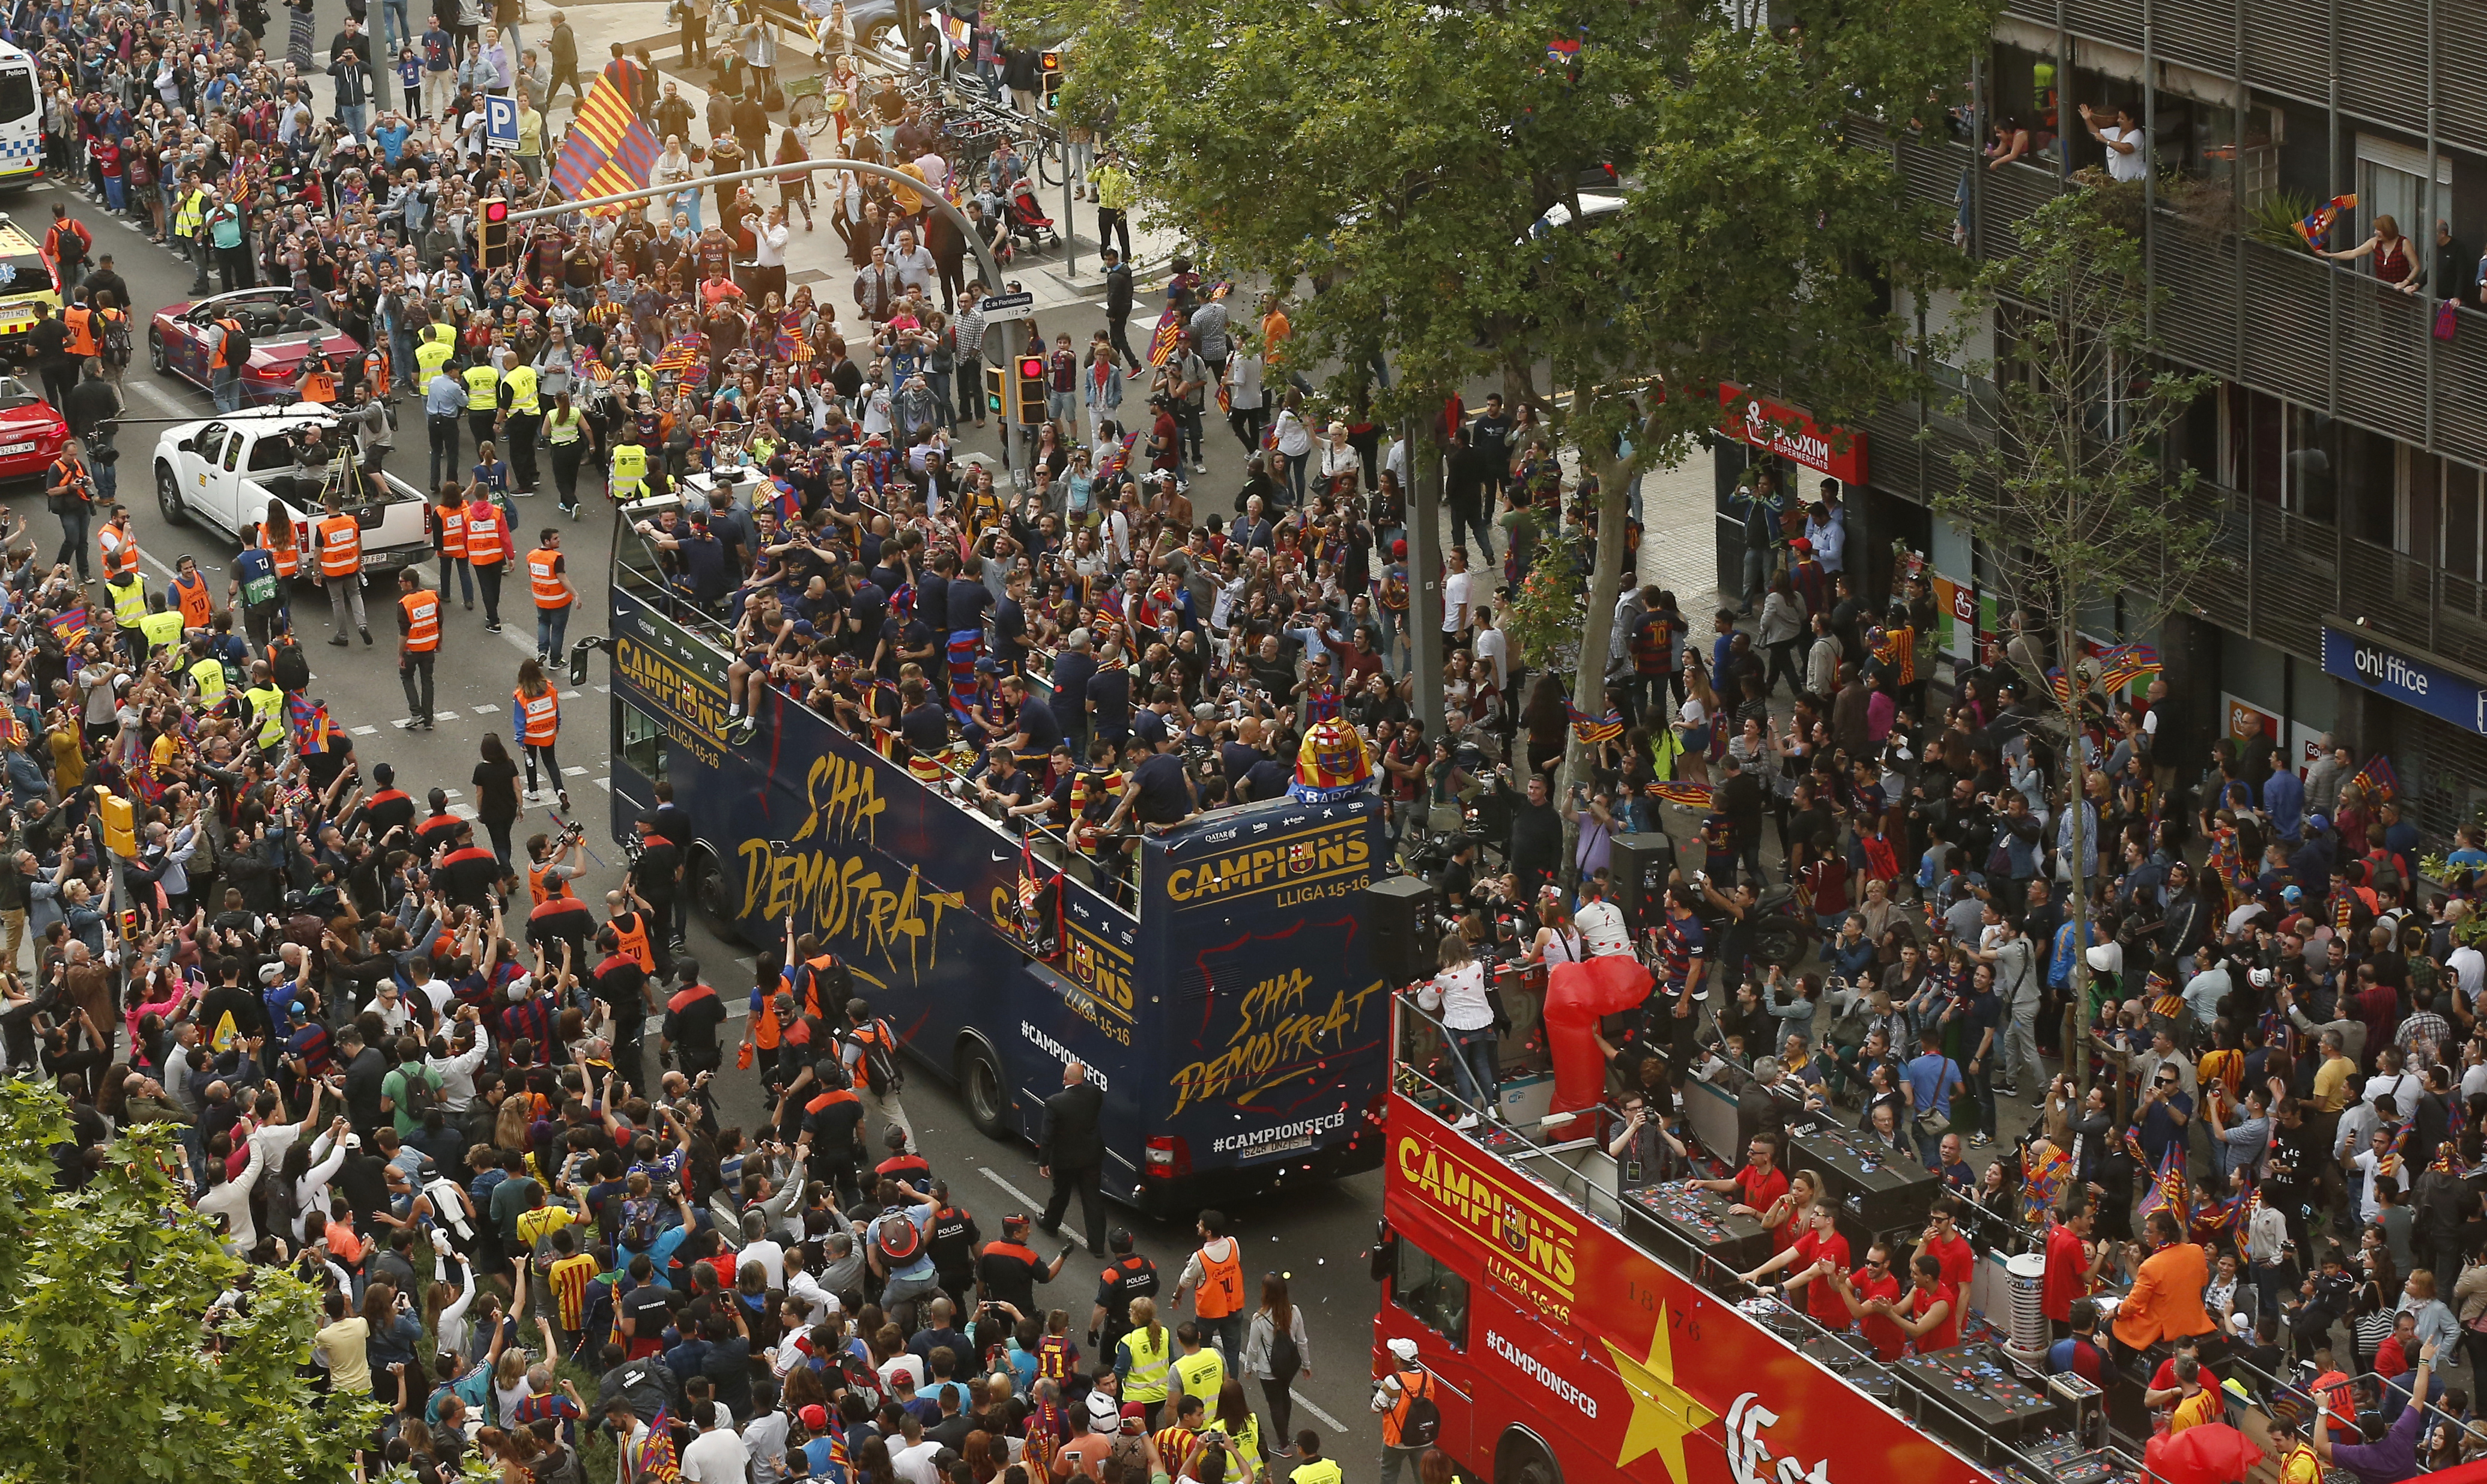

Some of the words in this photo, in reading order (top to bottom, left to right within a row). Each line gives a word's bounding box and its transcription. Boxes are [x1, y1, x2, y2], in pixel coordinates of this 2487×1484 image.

[491, 101, 510, 134] P
[999, 295, 1029, 305] Floridablanca
[16, 309, 29, 317] HZT
[317, 378, 330, 390] TU
[1774, 442, 1828, 470] SUPERMERCATS
[256, 558, 270, 571] TJ
[192, 597, 205, 613] TU
[668, 721, 694, 753] LLIGA
[695, 744, 719, 769] 15-16
[1205, 831, 1228, 842] QATAR
[1253, 822, 1268, 831] beko
[1277, 885, 1325, 908] LLIGA
[1328, 874, 1370, 897] 15-16
[735, 837, 965, 989] DEMOSTRAT
[1064, 989, 1098, 1026] LLIGA
[1100, 1016, 1130, 1046] 15-16
[1165, 979, 1384, 1121] DEMOSTRAT
[1213, 1112, 1345, 1152] #CAMPIONSFCB
[938, 1223, 963, 1235] POLICIA
[1126, 1274, 1150, 1285] POLICIA
[1488, 1256, 1530, 1297] LLIGA
[1531, 1290, 1571, 1325] 15-16
[624, 1370, 637, 1380] FIND
[1040, 1353, 1065, 1379] 11
[1486, 1329, 1598, 1420] #CAMPIONSFCB
[622, 1371, 646, 1389] YOURSELF
